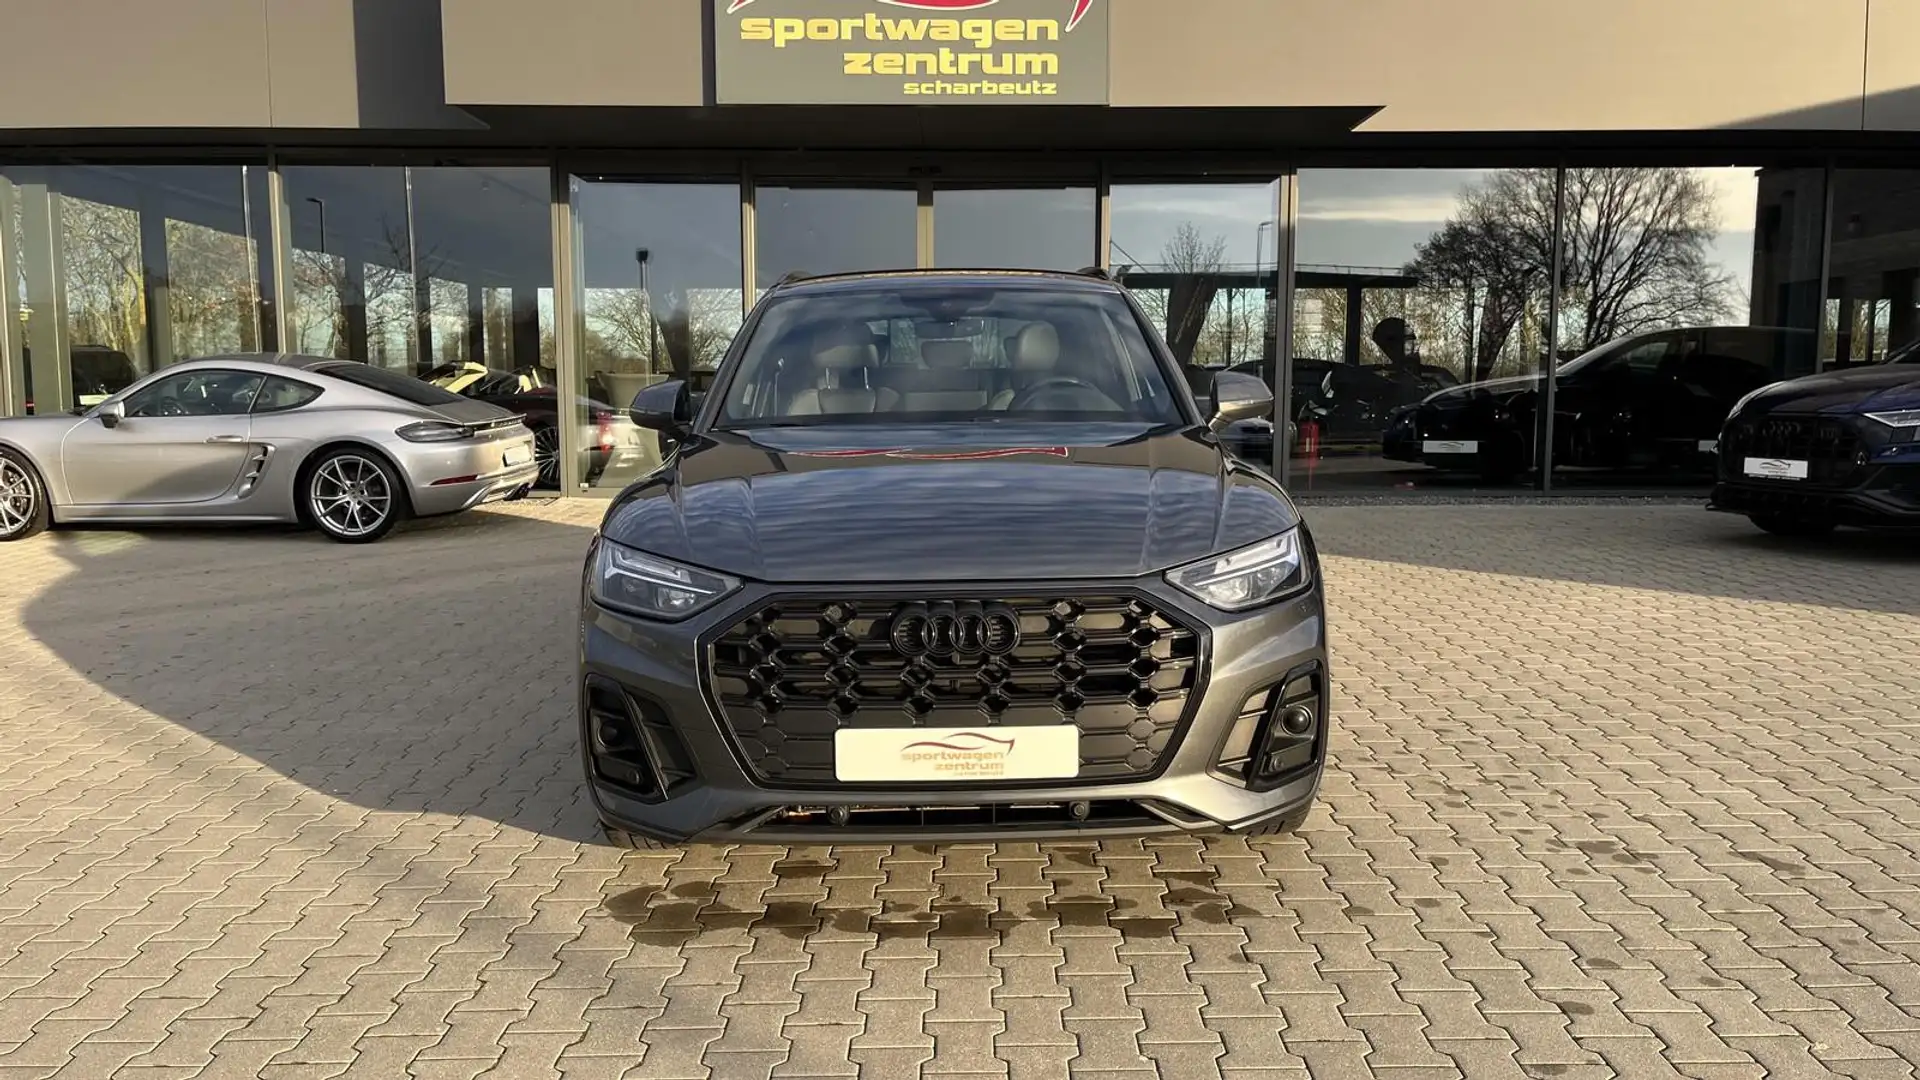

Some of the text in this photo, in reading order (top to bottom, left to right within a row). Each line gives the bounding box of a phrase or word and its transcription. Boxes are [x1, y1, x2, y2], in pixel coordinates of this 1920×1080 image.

[740, 13, 1059, 48] sportwagen
[843, 47, 1059, 75] zentrum
[903, 79, 1058, 96] scharbeutz
[902, 751, 1004, 762] sportwagen
[934, 761, 1004, 771] zentrum
